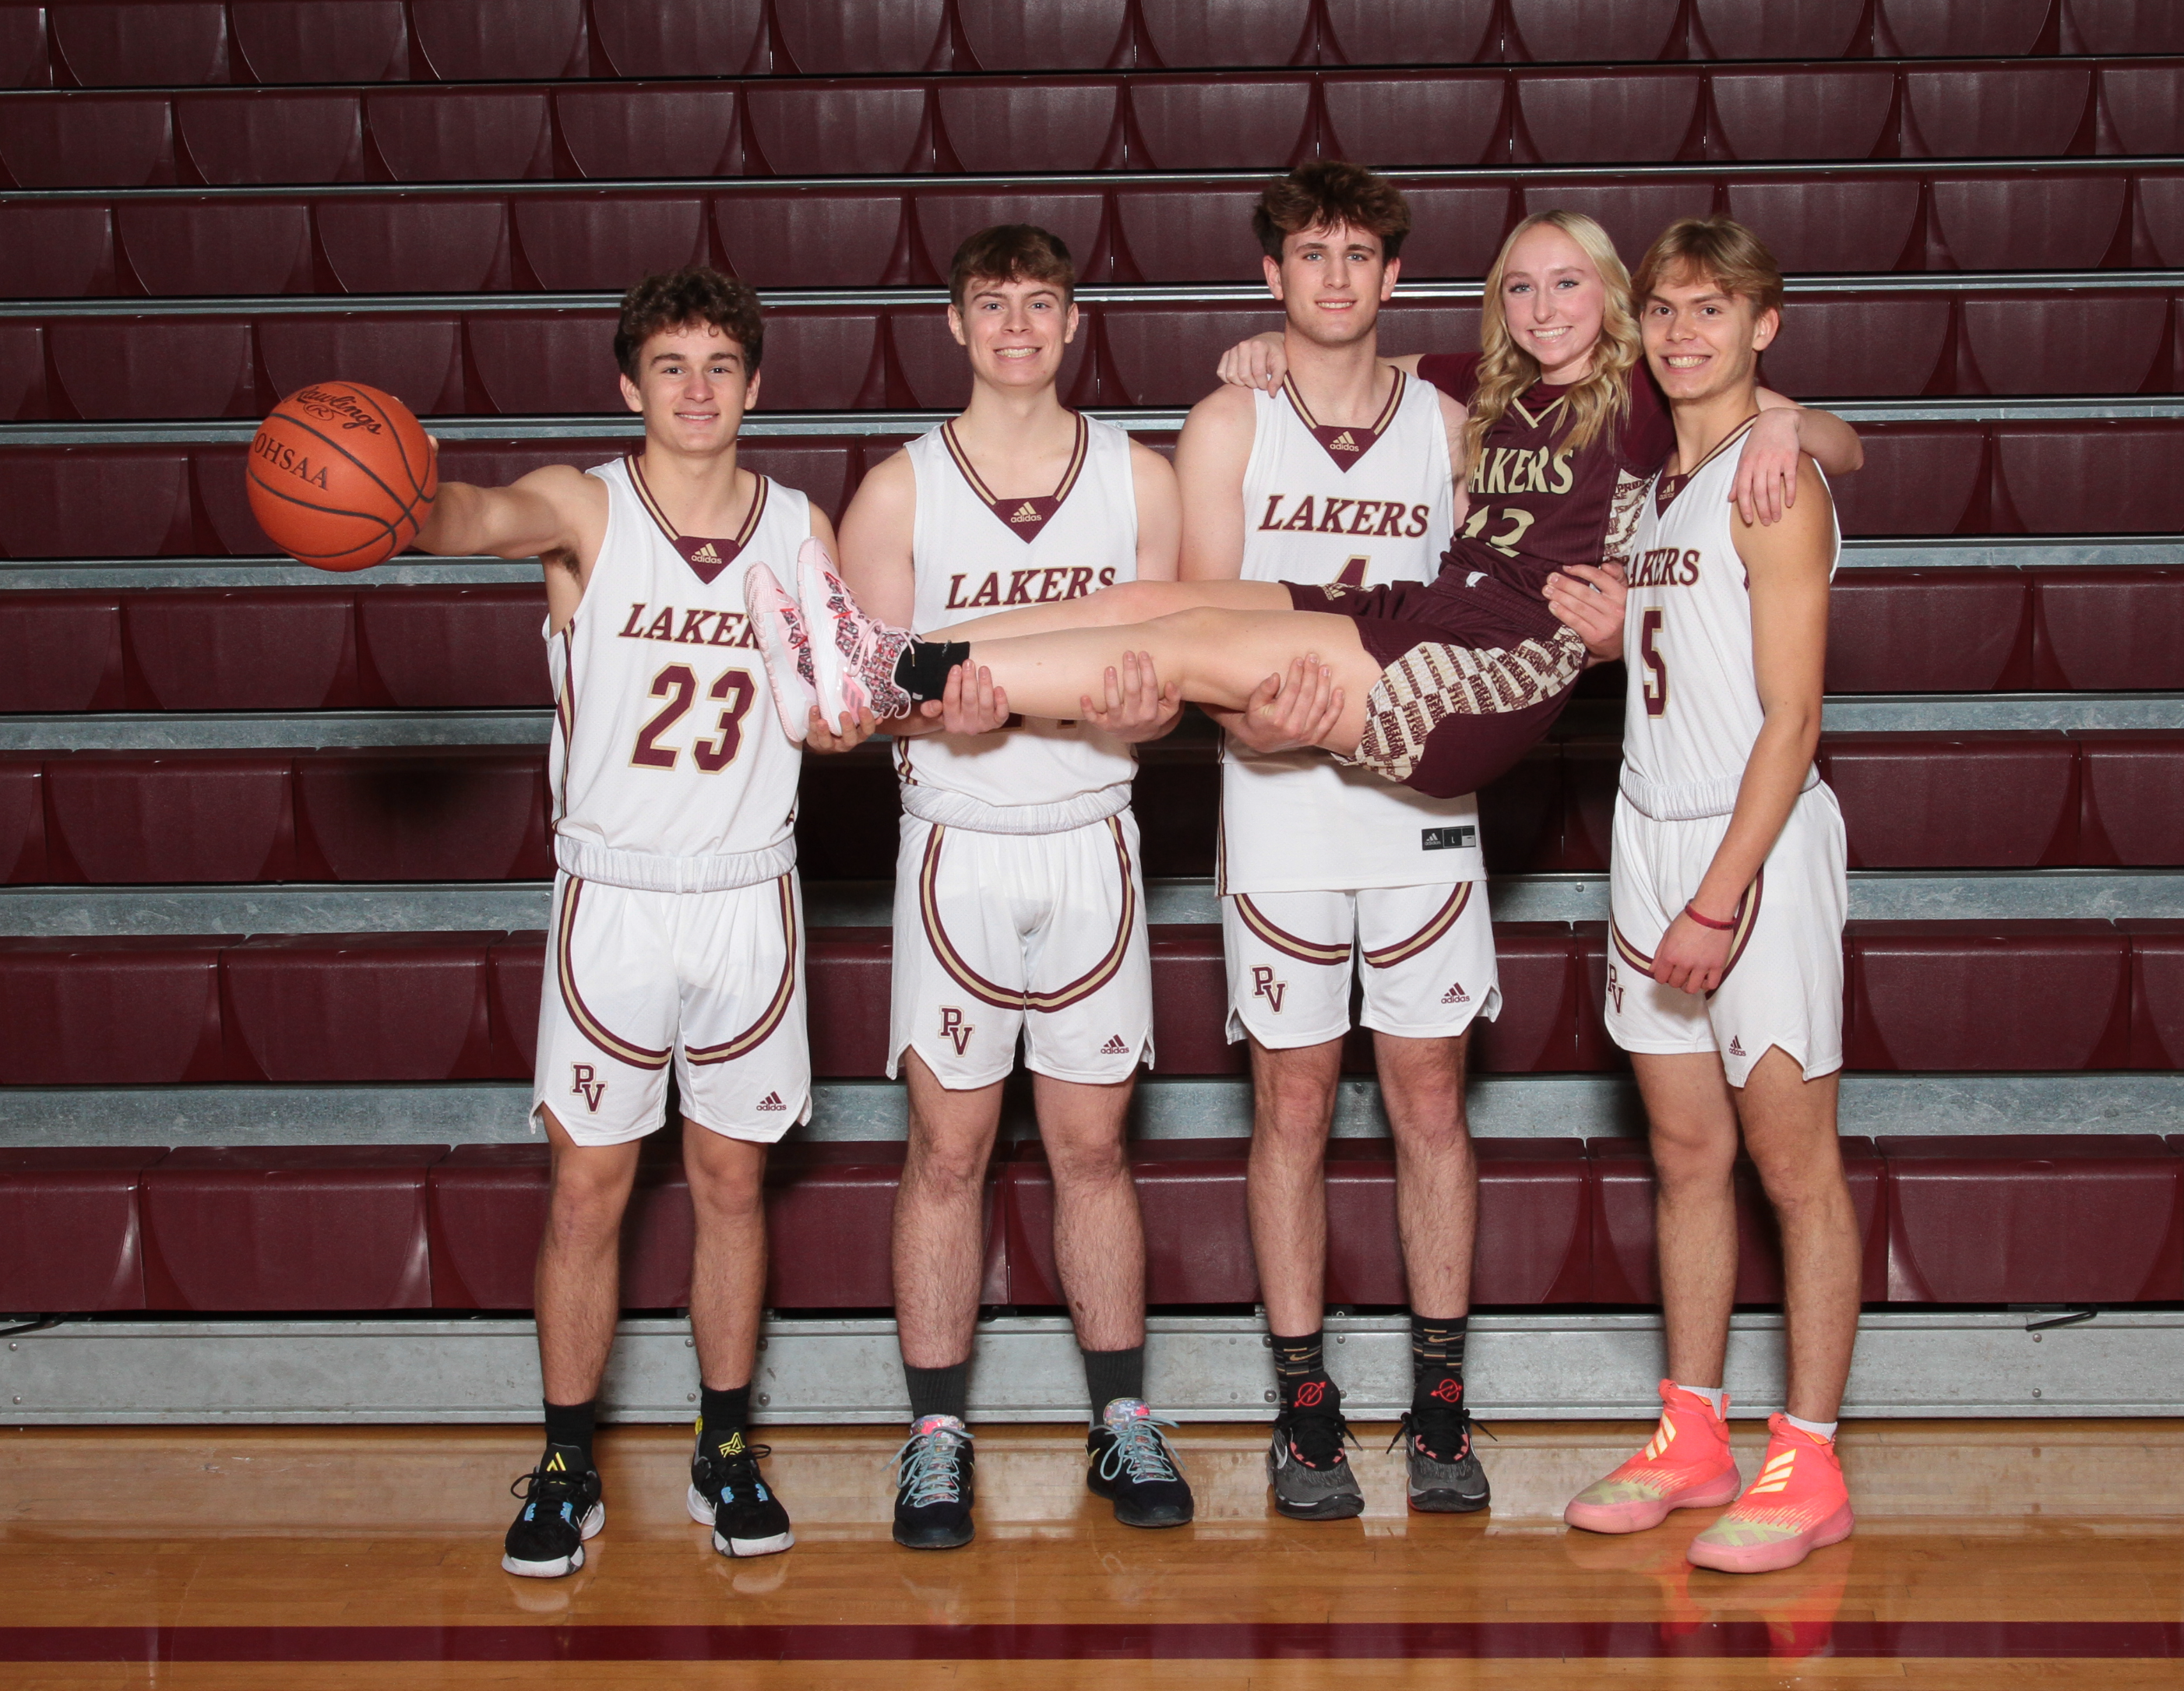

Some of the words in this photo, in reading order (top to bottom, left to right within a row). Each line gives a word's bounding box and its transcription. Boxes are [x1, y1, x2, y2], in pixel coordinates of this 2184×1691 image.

[285, 385, 381, 435] Rawlings
[254, 433, 329, 491] OHSAA
[1329, 442, 1359, 452] adidas
[1469, 446, 1573, 495] AKERS
[1010, 513, 1042, 523] adidas
[1257, 493, 1430, 539] LAKERS
[691, 554, 722, 565] adidas
[1628, 548, 1701, 588] AKERS
[944, 565, 1117, 611] LAKERS
[616, 602, 761, 651] LAKE
[1641, 606, 1669, 719] 5
[628, 661, 759, 775] 23
[1441, 995, 1471, 1004] adidas
[1100, 1046, 1129, 1055] adidas
[756, 1103, 787, 1111] adidas
